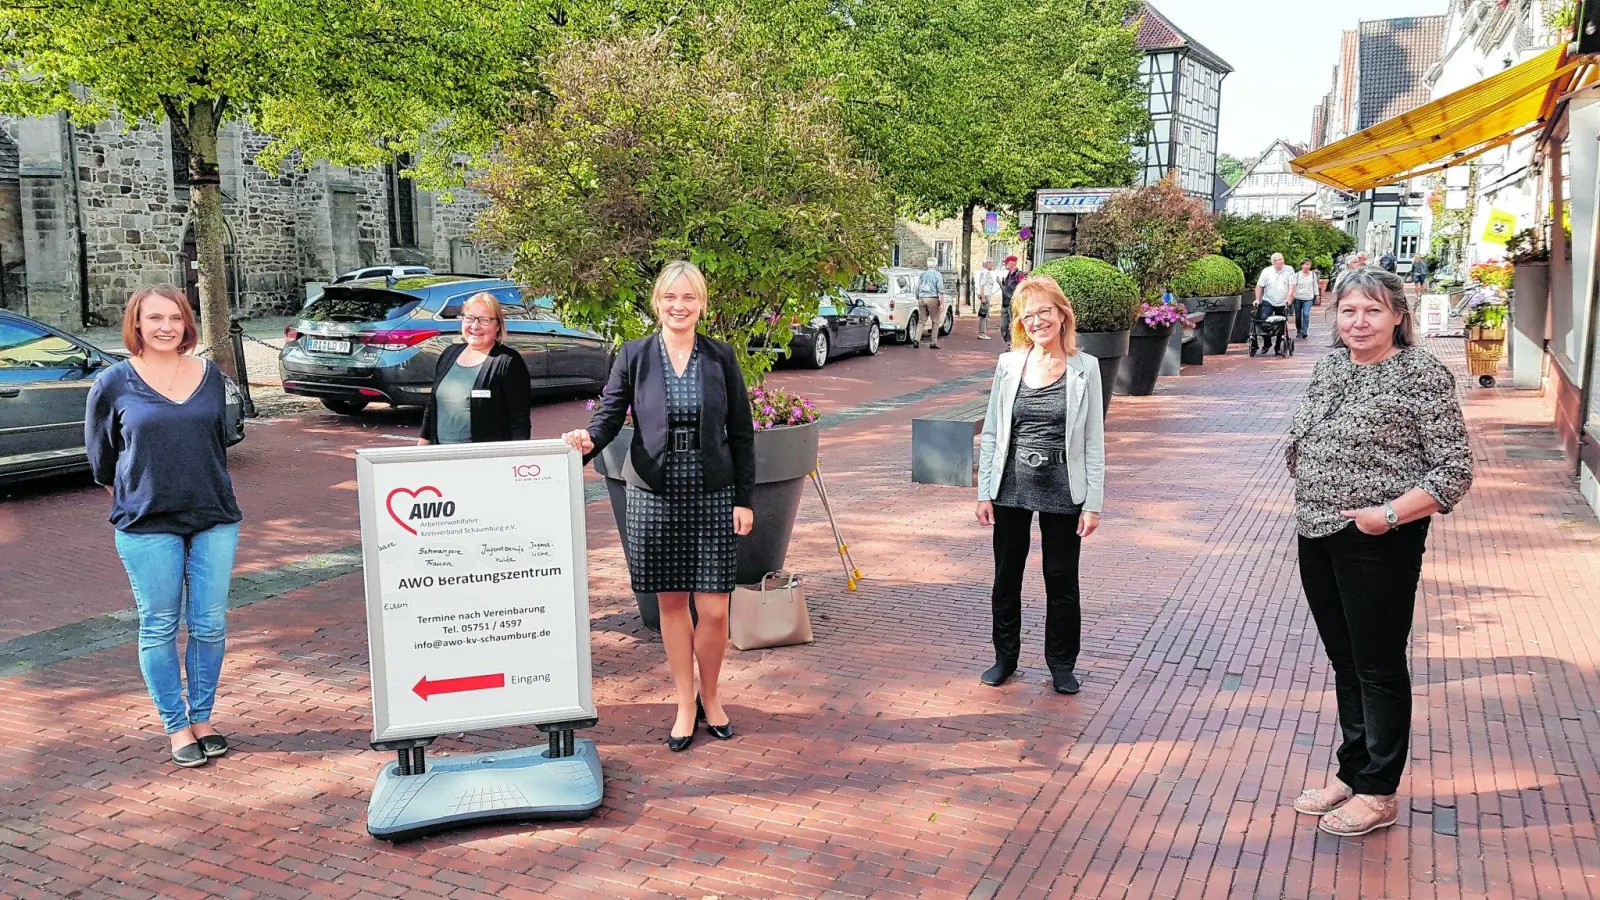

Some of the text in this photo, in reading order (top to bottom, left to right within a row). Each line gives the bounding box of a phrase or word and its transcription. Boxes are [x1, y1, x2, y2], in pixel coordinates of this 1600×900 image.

[313, 340, 321, 350] RI
[339, 342, 348, 352] 99
[409, 500, 456, 520] AWO
[420, 518, 478, 528] Arbeiterwohlfahrt
[420, 528, 463, 537] Kreisverband
[464, 525, 504, 533] Schaumburg
[425, 559, 455, 567] Frauen
[398, 567, 562, 589] AWO Beratungszentrum
[417, 606, 546, 624] Termine nach Vereinbarung
[442, 619, 522, 634] Tel. 05751 / 4597
[414, 629, 551, 649] info@awo-kv-schaumburg.de
[511, 673, 551, 684] Eingang
